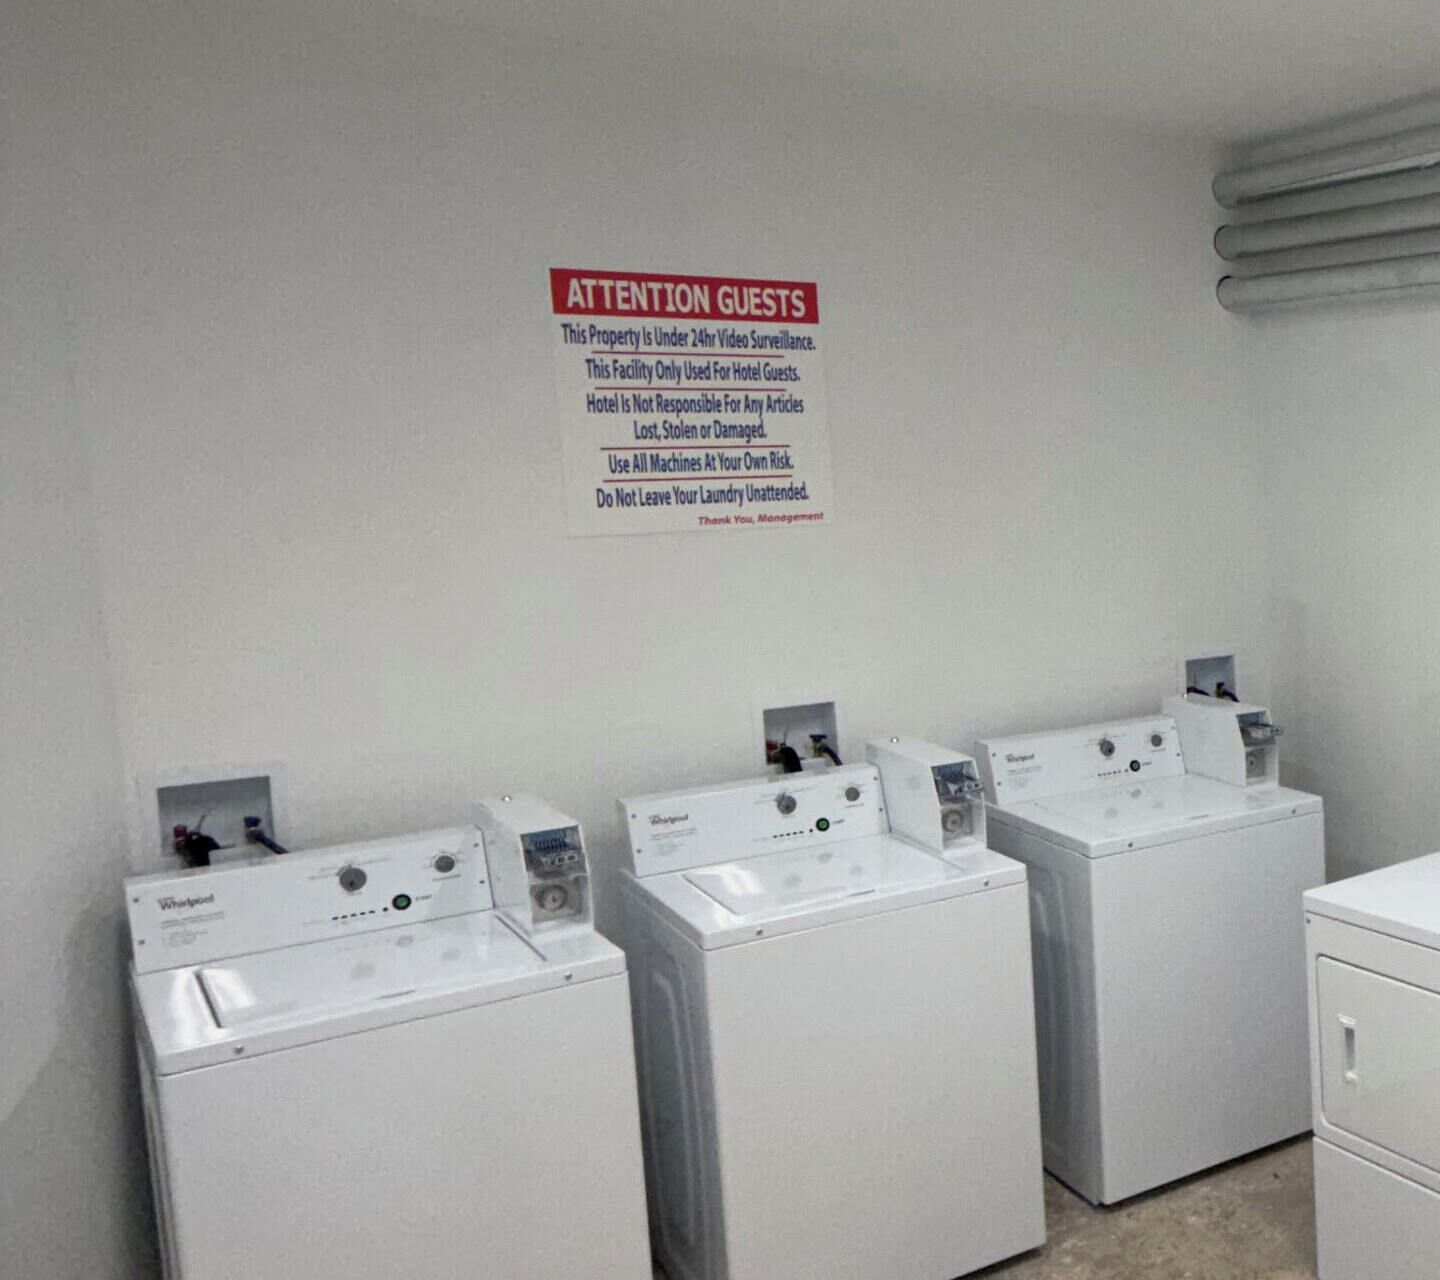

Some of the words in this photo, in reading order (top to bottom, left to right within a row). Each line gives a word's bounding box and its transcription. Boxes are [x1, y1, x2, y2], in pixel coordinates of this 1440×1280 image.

[567, 278, 711, 314] ATTENTION
[717, 285, 806, 318] GUESTS
[561, 323, 586, 344] This
[589, 324, 640, 351] Property
[642, 326, 652, 346] Is
[654, 326, 688, 347] Under
[691, 328, 716, 348] 24hr
[717, 328, 748, 349] Video
[751, 330, 816, 351] Surveillance.
[585, 358, 610, 379] This
[612, 358, 653, 385] Facility
[656, 359, 681, 385] Only
[684, 360, 711, 380] Used
[713, 361, 731, 380] For
[732, 361, 761, 381] Hotel
[763, 362, 801, 381] Guests.
[586, 393, 618, 413] Hotel
[621, 393, 630, 413] Is
[632, 393, 654, 413] Not
[656, 392, 722, 419] Responsible
[724, 393, 741, 413] For
[743, 393, 763, 418] Any
[766, 393, 804, 413] Articles
[634, 420, 661, 442] Lost,
[662, 419, 698, 440] Stolen
[700, 424, 711, 439] or
[713, 419, 767, 444] Damaged.
[608, 453, 630, 474] Use
[632, 452, 648, 473] All
[650, 451, 702, 472] Machines
[704, 452, 717, 472] At
[717, 451, 741, 471] Your
[744, 451, 768, 470] Own
[769, 449, 794, 469] Risk.
[596, 488, 613, 508] Do
[615, 487, 637, 507] Not
[639, 487, 672, 506] Leave
[672, 485, 698, 505] Your
[699, 483, 744, 508] Laundry
[745, 481, 809, 503] Unattended.
[698, 515, 732, 525] Thank
[733, 515, 755, 524] You,
[757, 512, 824, 523] Management
[158, 893, 215, 910] Whirlpool
